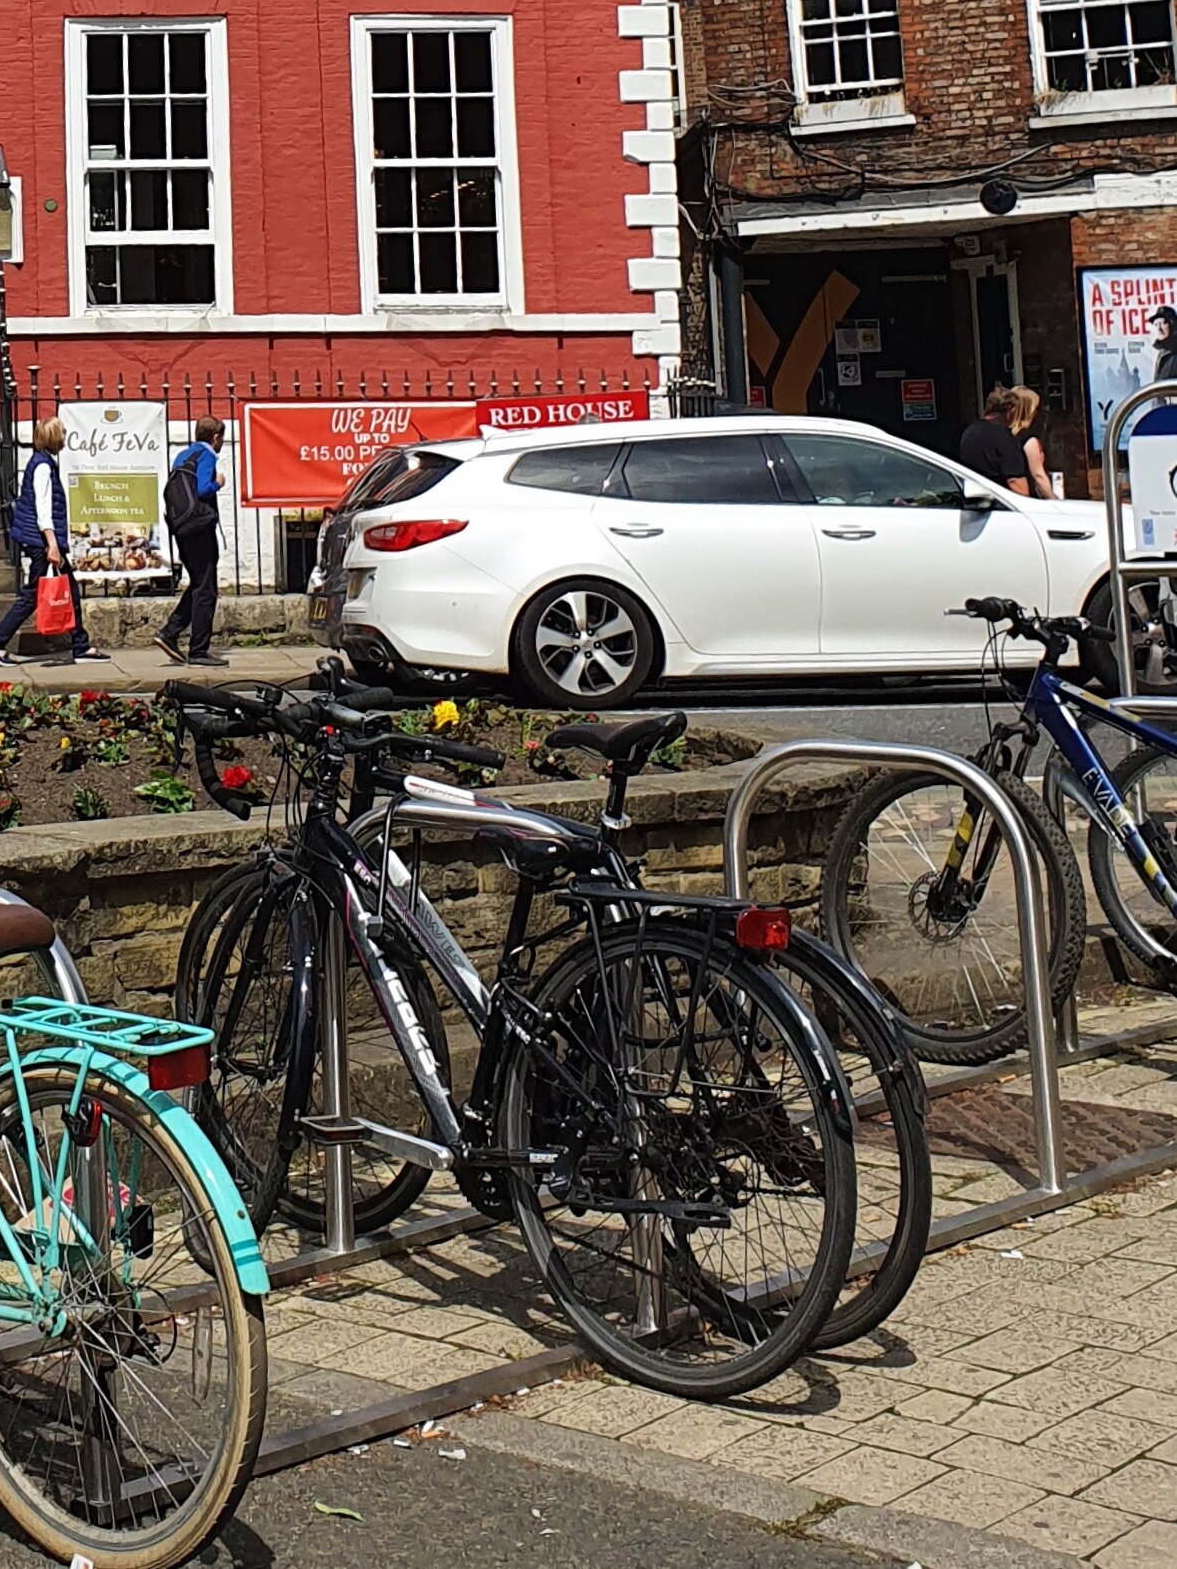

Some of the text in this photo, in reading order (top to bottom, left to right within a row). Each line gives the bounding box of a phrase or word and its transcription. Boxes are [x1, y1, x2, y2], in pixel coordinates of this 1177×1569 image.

[1091, 283, 1104, 307] A
[1092, 308, 1151, 335] OF ICE
[331, 408, 411, 434] WE PAY
[489, 400, 634, 426] RED HOUSE
[67, 428, 159, 457] Café FeVa
[354, 432, 390, 444] UP TO
[300, 445, 355, 461] £15.00
